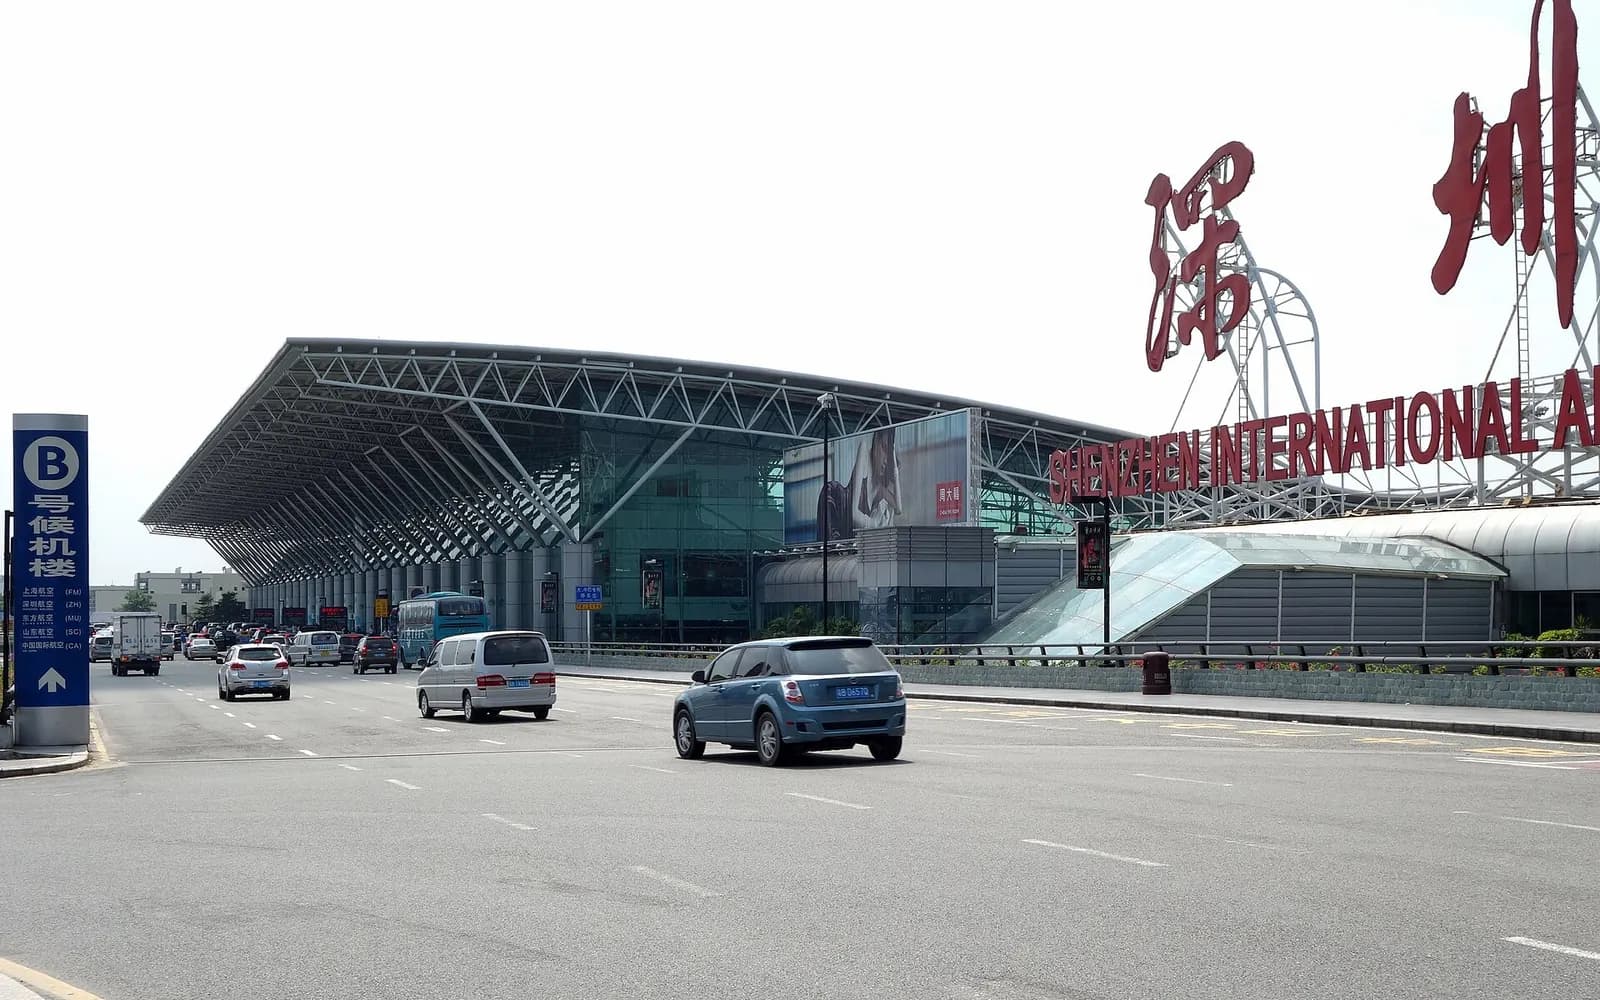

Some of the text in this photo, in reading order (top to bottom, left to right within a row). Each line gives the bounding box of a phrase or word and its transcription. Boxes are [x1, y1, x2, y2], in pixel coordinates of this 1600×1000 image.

[1049, 429, 1200, 504] SHENZHEN
[1210, 377, 1539, 488] INTERNATIONAL
[38, 445, 69, 481] B
[27, 494, 77, 578] 号候机楼
[22, 587, 82, 596] 上海航空 (FM)
[22, 600, 82, 609] 深圳航空 (ZH)
[22, 614, 82, 623] 东方航空 (MU)
[22, 628, 82, 637] 山东航空 (SC)
[22, 641, 82, 651] 中国国际航空 (CA)
